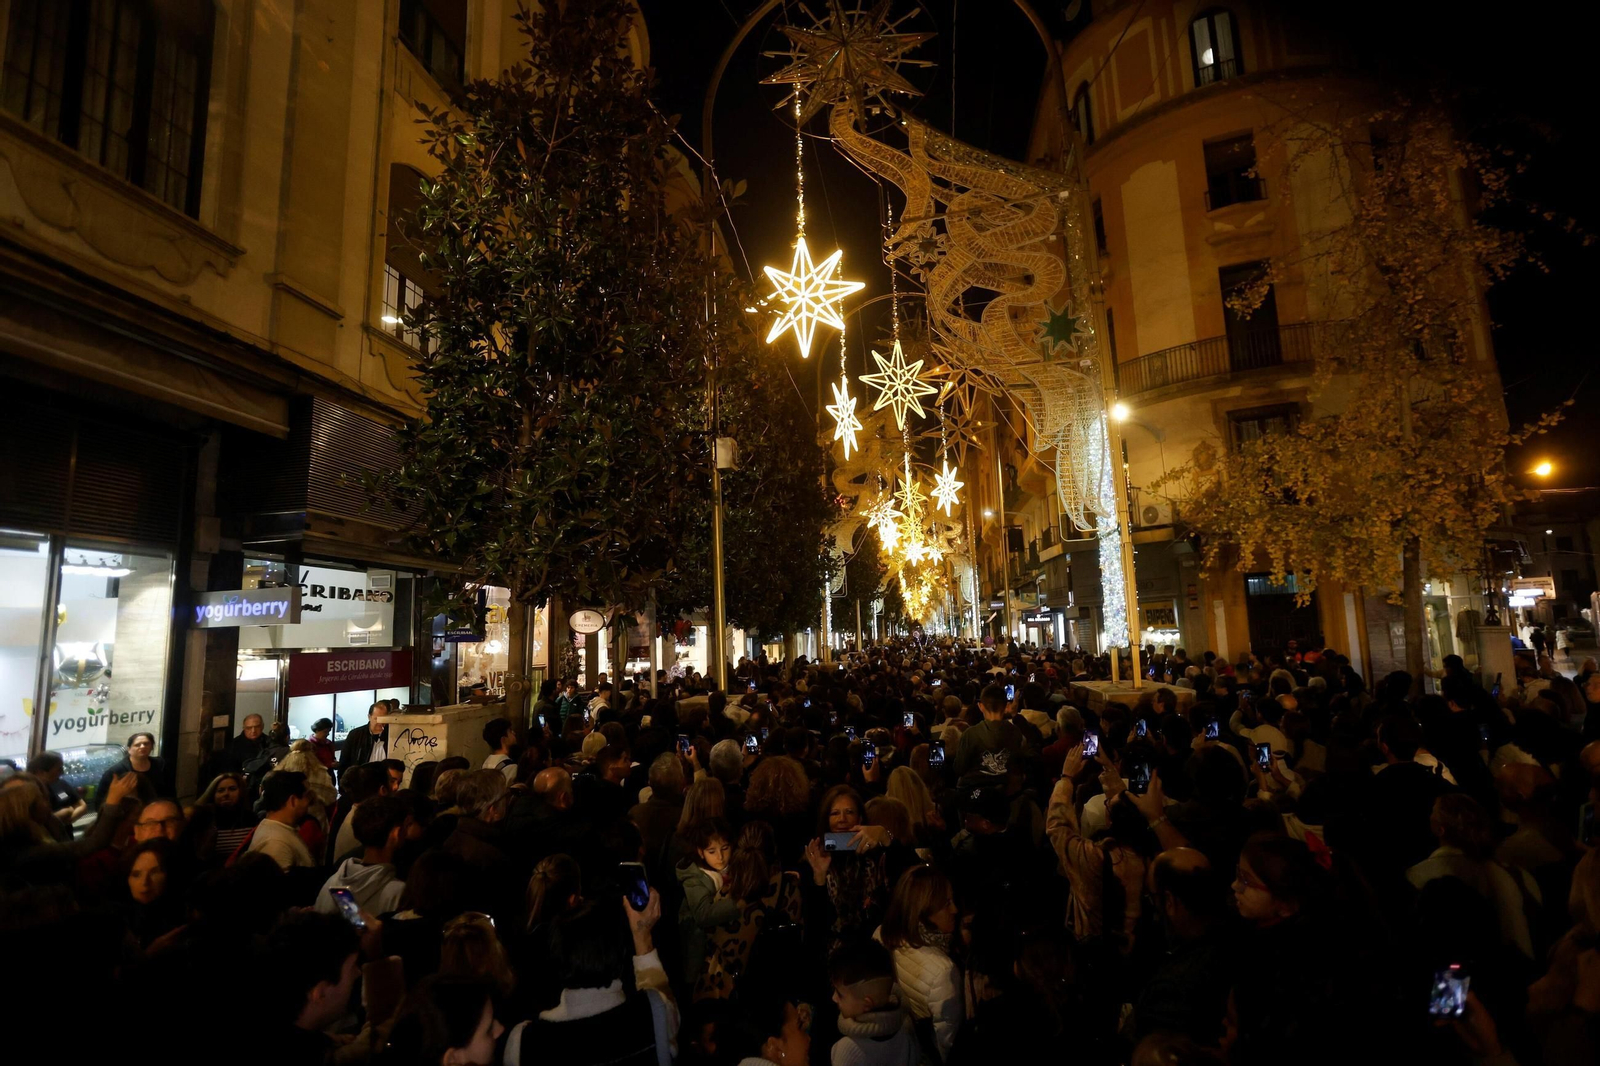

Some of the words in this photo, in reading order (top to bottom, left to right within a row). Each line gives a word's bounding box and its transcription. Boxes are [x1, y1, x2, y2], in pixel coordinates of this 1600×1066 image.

[196, 599, 289, 624] yogurberry
[327, 658, 387, 672] ESCRIBANO
[340, 673, 347, 681] de
[53, 709, 155, 735] yogurberry
